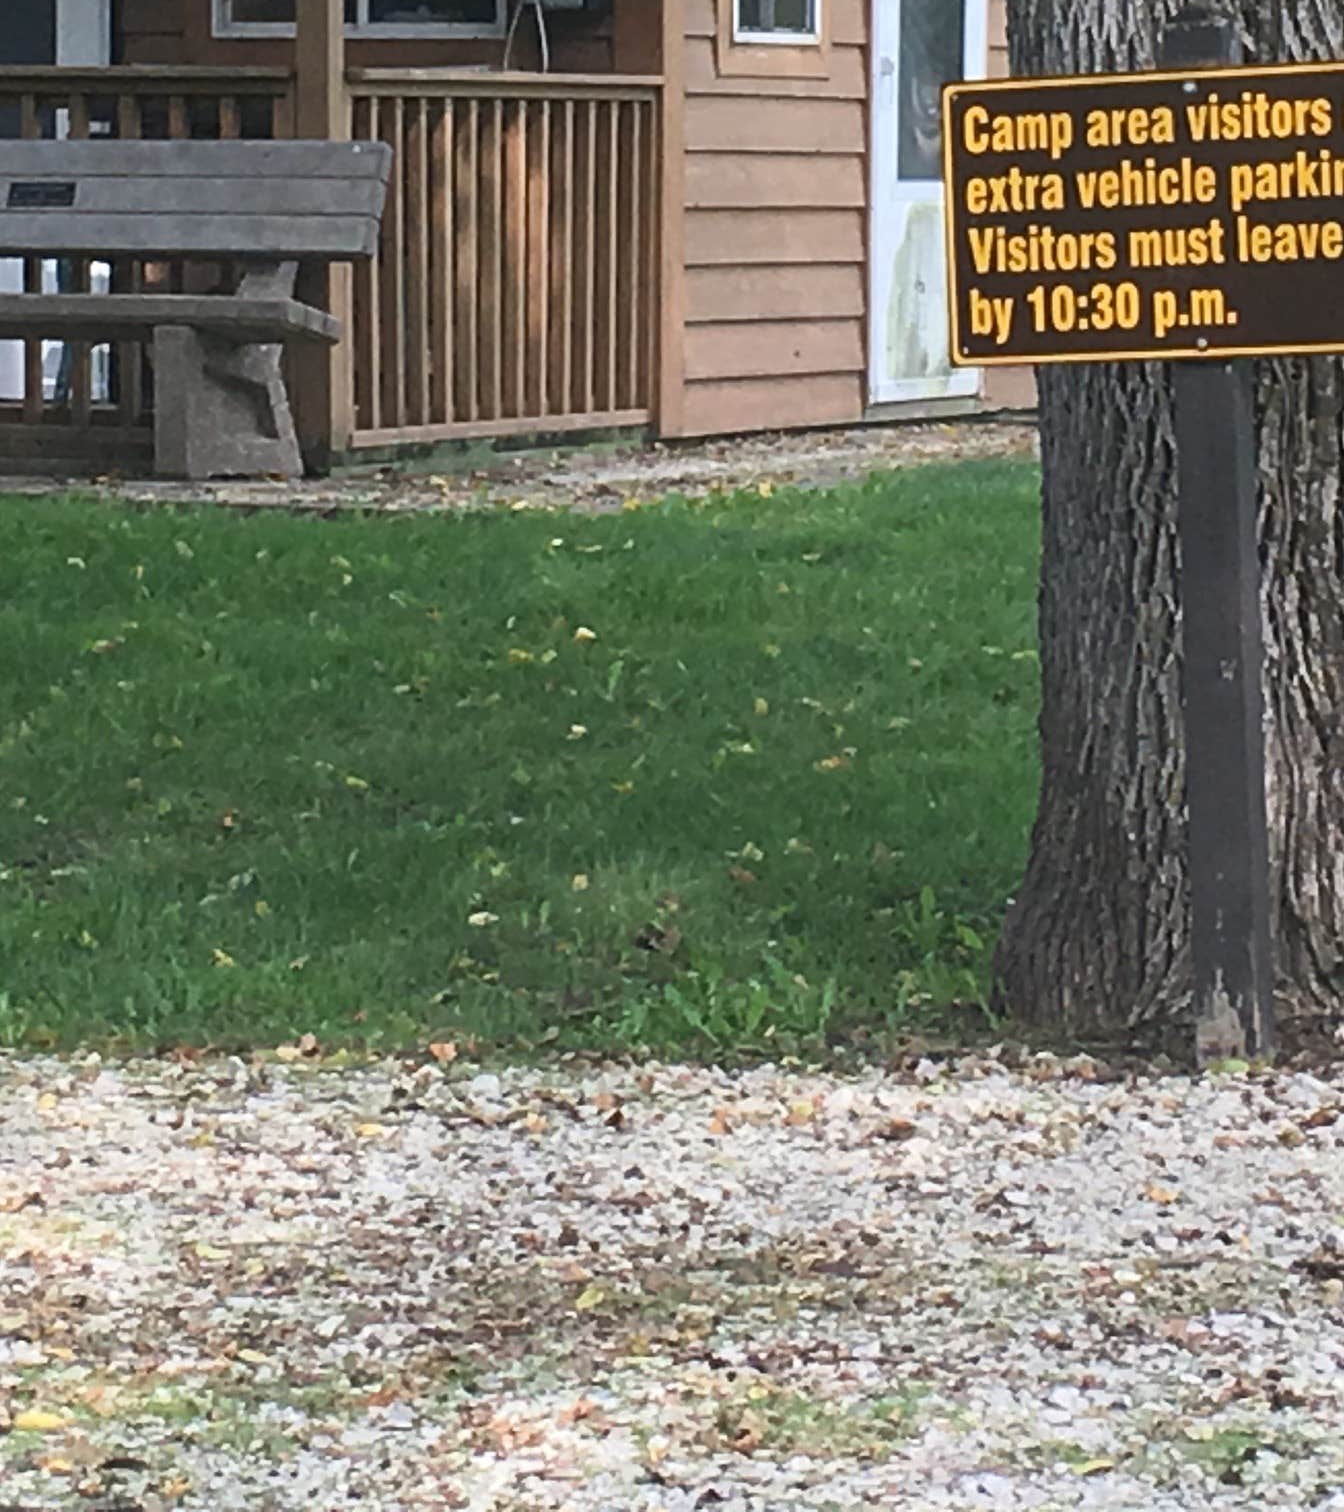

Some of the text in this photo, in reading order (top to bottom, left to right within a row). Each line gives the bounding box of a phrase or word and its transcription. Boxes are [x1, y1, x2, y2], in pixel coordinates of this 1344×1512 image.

[963, 105, 1073, 160] Camp
[1086, 106, 1175, 147] area
[1186, 91, 1332, 142] visitors
[966, 166, 1065, 215] extra
[1076, 157, 1216, 209] vehicle
[967, 215, 1344, 274] Visitors must leave
[969, 281, 1238, 345] by 10:30 p.m.
